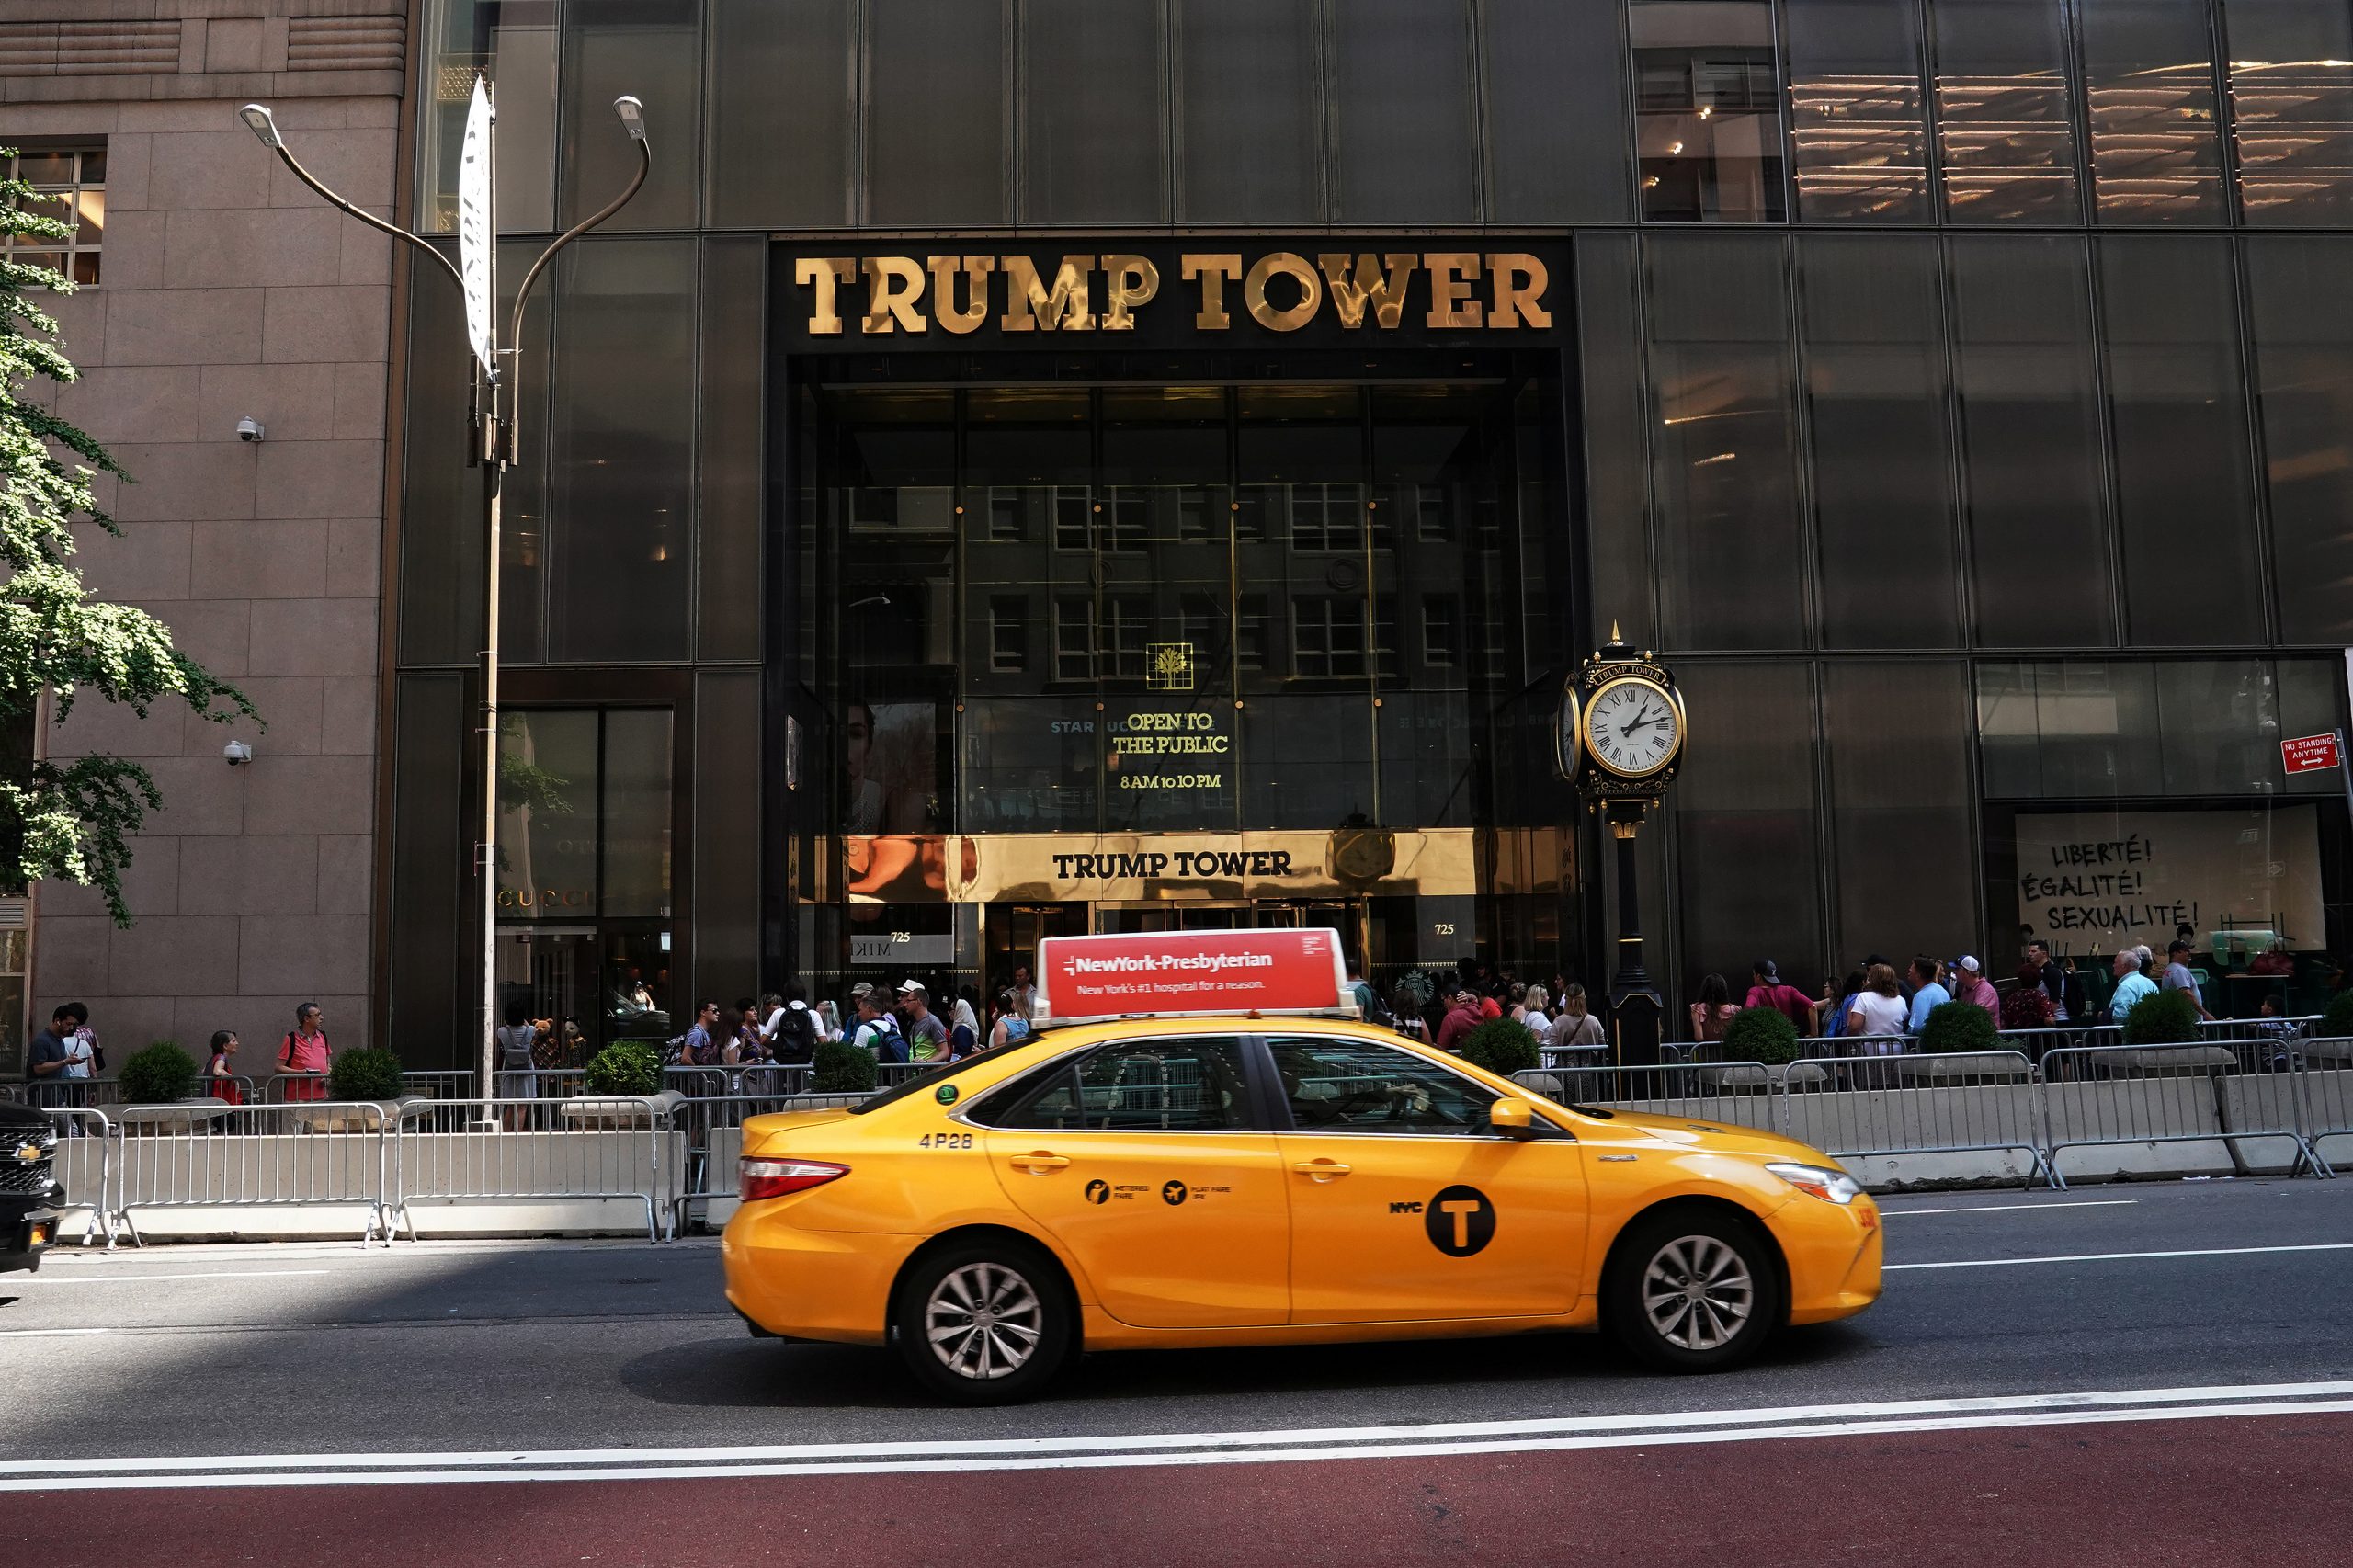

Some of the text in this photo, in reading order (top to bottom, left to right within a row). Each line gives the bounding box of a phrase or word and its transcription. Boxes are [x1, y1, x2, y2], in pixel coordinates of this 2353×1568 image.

[795, 252, 1552, 335] TRUMP TOWER
[1597, 665, 1660, 680] TRUMP TOWER
[1127, 712, 1182, 732] OPEN
[1183, 712, 1213, 731] TO
[1113, 735, 1229, 754] THE PUBLIC
[2285, 737, 2332, 751] NO STANDING
[2292, 746, 2328, 759] ANYTIME
[1161, 777, 1176, 789] to
[2052, 833, 2152, 869] LIBERTÉ!
[1052, 850, 1292, 879] TRUMP TOWER
[2022, 871, 2143, 903] ÉGALITÉ!
[2048, 899, 2199, 932] SEXUALITÉ!
[891, 931, 911, 943] 725
[1434, 924, 1454, 935] 725
[1075, 951, 1273, 973] NewYork-Presbyterian
[1077, 980, 1266, 995] New York's #1 hospital for a reason.
[919, 1133, 972, 1149] 4P28
[1389, 1200, 1480, 1248] NYC T
